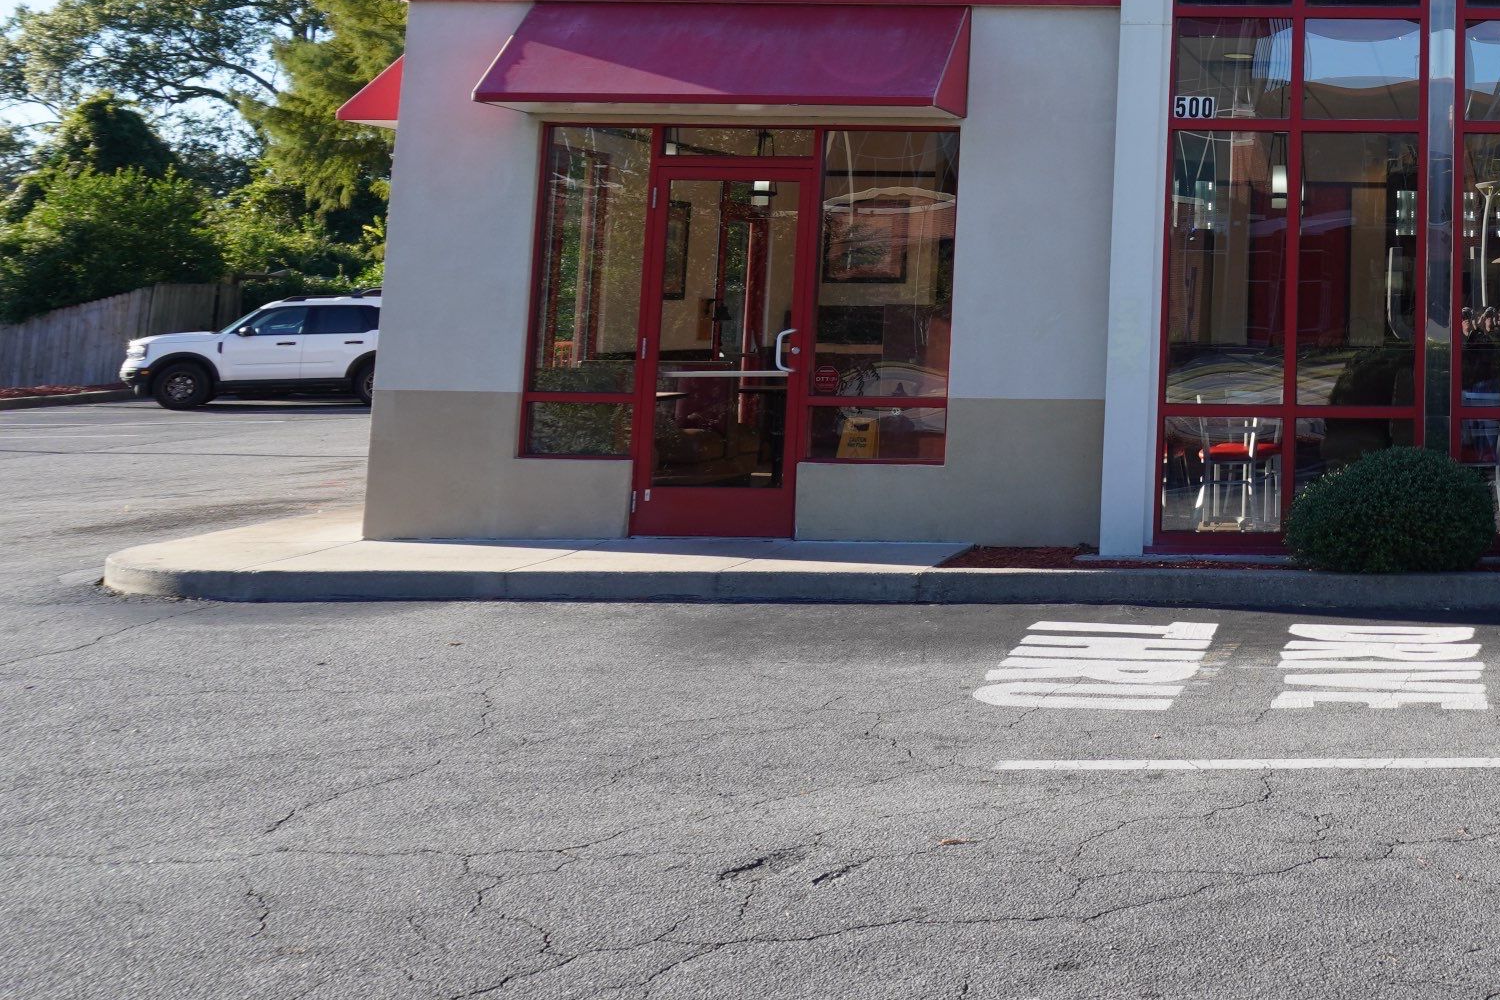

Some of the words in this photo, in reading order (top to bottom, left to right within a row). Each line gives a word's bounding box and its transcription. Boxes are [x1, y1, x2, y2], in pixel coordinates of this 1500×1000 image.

[1175, 97, 1213, 118] 500
[973, 620, 1219, 711] THRU
[1270, 623, 1489, 710] DRIVE
